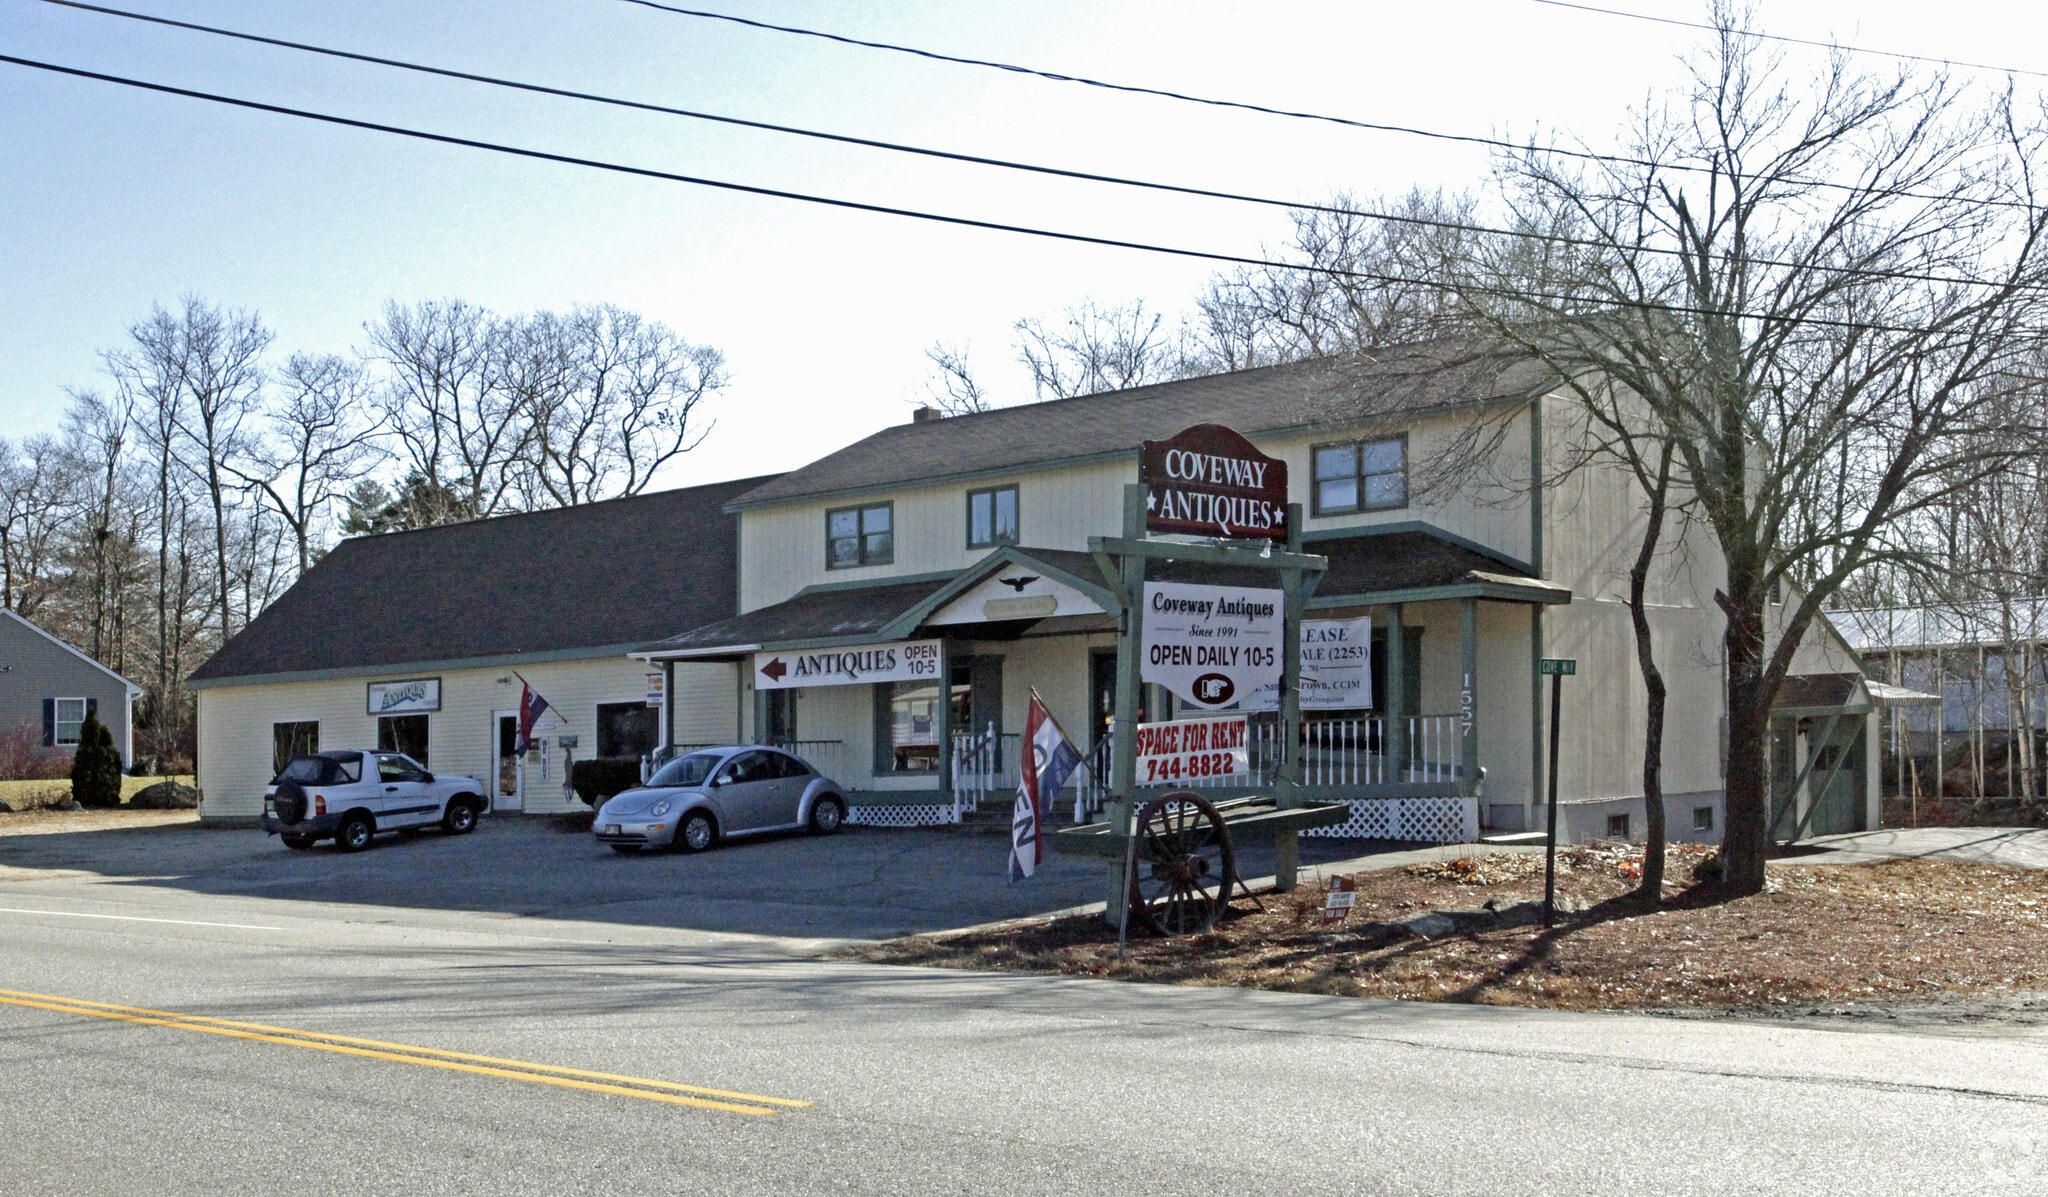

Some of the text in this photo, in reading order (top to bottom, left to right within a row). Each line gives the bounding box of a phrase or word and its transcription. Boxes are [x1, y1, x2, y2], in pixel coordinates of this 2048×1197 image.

[1165, 449, 1268, 489] COVEWAY
[1159, 489, 1271, 535] ANTIQUES
[1153, 592, 1274, 622] Coveway Antiques
[1189, 624, 1238, 638] Since 1991
[1300, 628, 1349, 643] EASE
[794, 648, 896, 679] ANTIQUES
[904, 645, 937, 660] OPEN
[908, 660, 935, 674] 10-5
[1150, 644, 1274, 667] OPEN DAILY 10-5
[1301, 646, 1368, 662] ALE (2253)
[1461, 673, 1472, 736] 1557
[1136, 720, 1246, 757] SPACE FOR RENT
[1147, 752, 1234, 782] 744-8822
